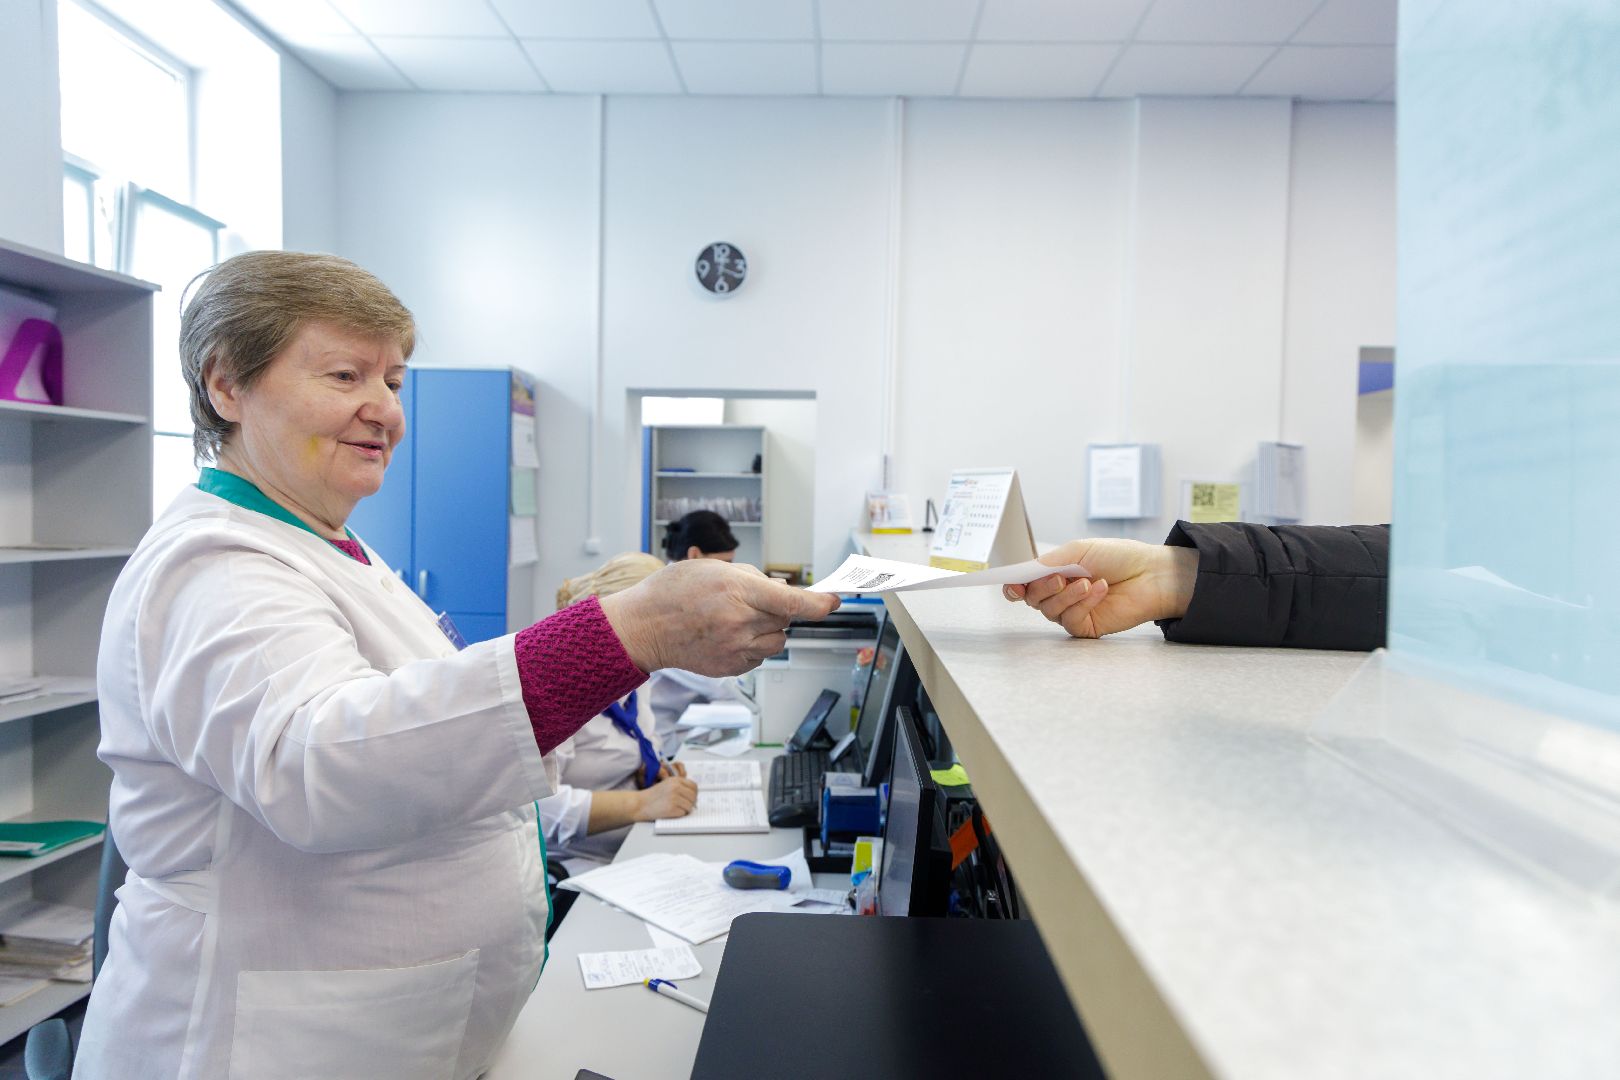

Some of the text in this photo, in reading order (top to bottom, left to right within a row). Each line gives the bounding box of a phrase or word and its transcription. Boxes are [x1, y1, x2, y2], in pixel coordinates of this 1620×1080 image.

[713, 244, 731, 263] 12
[697, 259, 710, 279] 9
[734, 258, 747, 279] 3
[714, 276, 729, 293] 6
